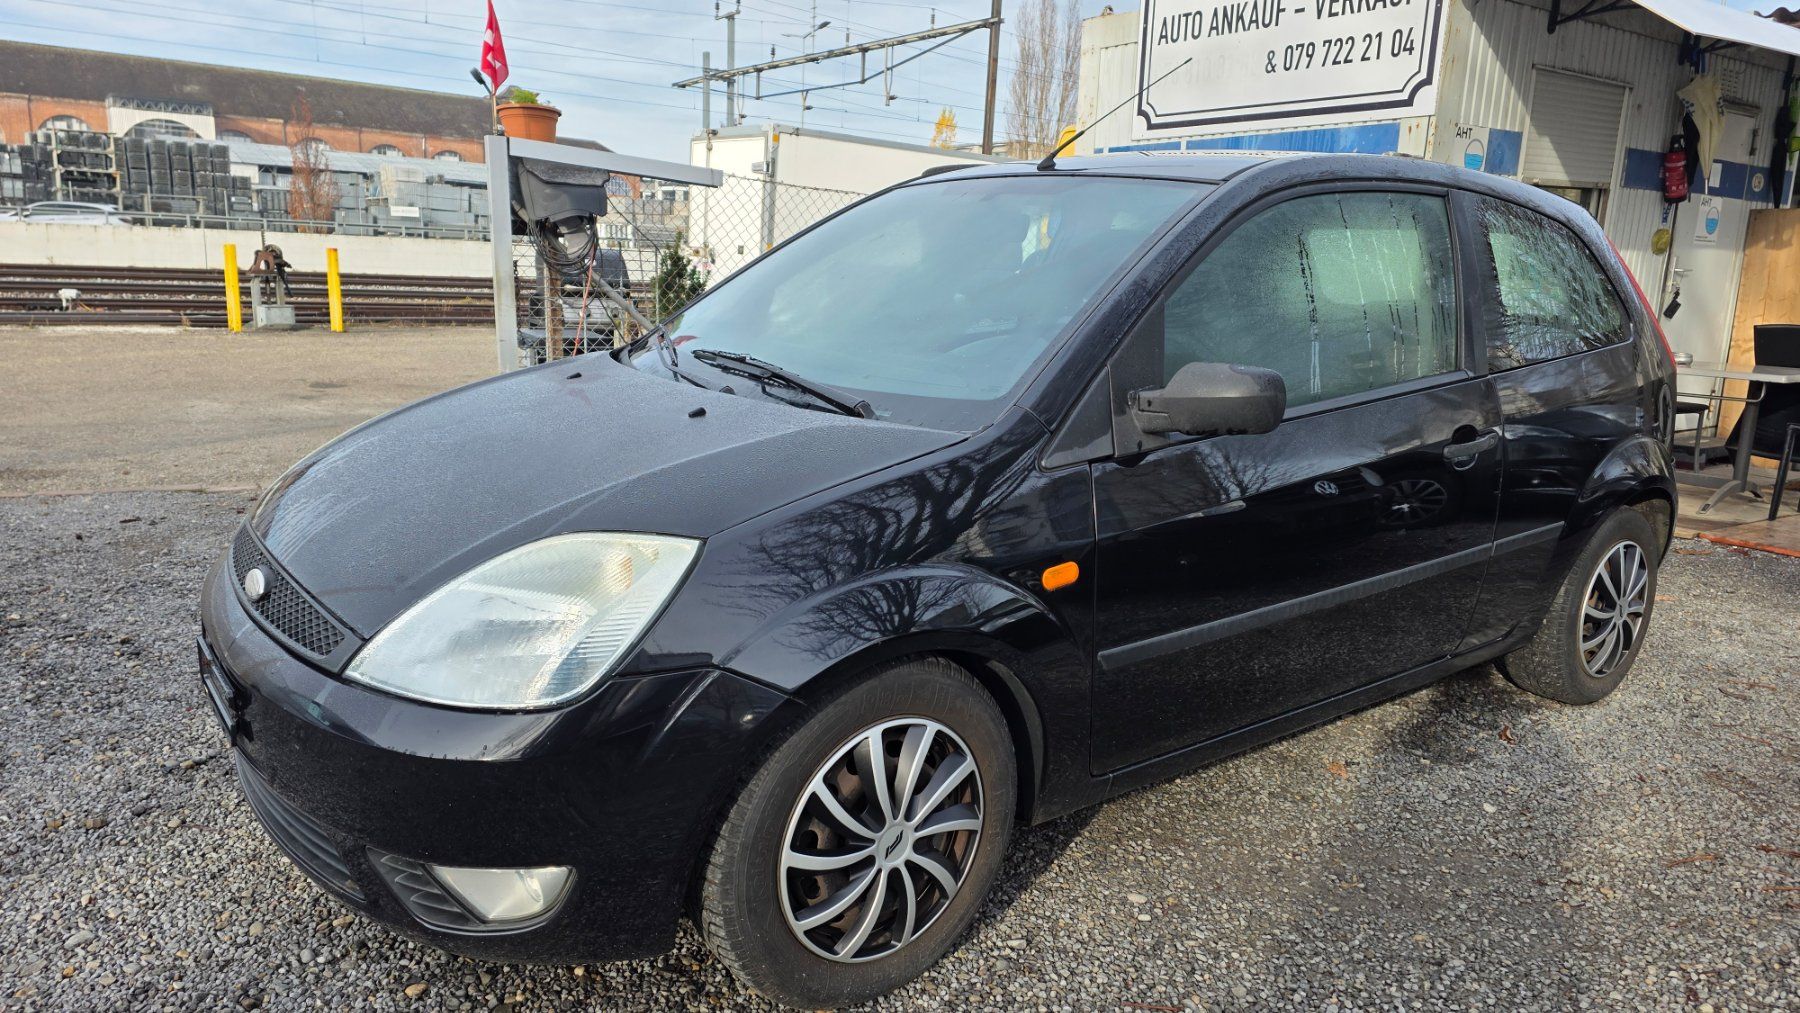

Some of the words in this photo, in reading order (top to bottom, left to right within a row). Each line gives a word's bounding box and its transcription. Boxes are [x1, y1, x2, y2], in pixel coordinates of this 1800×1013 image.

[1157, 10, 1203, 46] AUTO
[1207, 0, 1287, 38] ANKAUF
[1265, 49, 1277, 74] &
[1283, 41, 1316, 72] 079
[1321, 35, 1356, 67] 722
[1360, 31, 1383, 62] 21
[1390, 26, 1415, 58] 04
